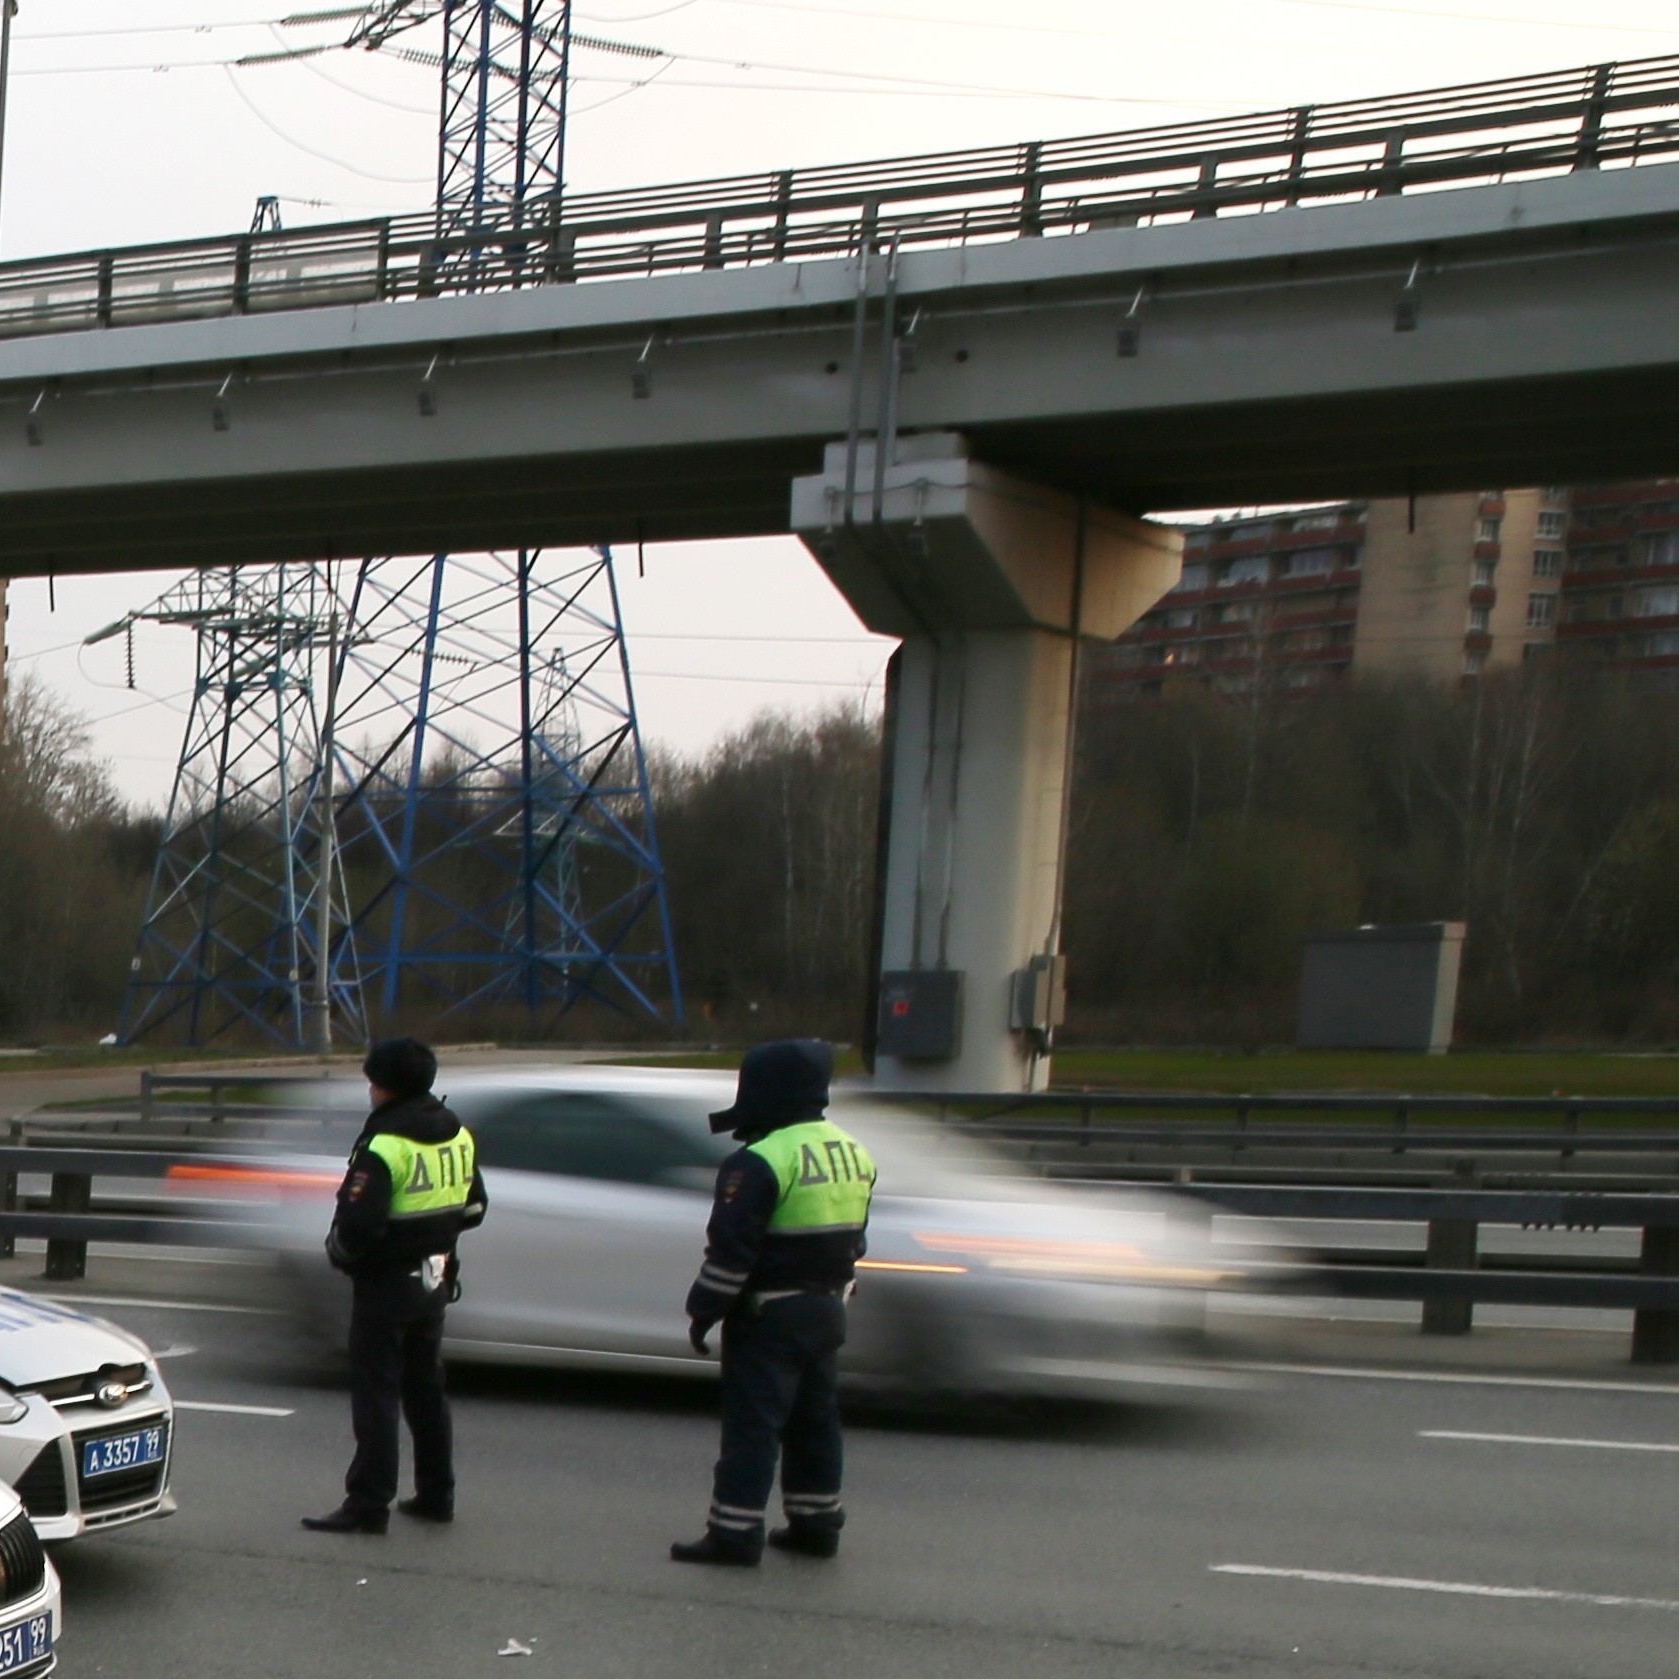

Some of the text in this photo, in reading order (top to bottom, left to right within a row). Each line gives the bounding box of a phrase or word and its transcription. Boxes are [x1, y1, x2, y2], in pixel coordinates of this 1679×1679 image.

[90, 1436, 140, 1471] А 3357
[146, 1430, 160, 1451] 99
[30, 1617, 46, 1647] 99
